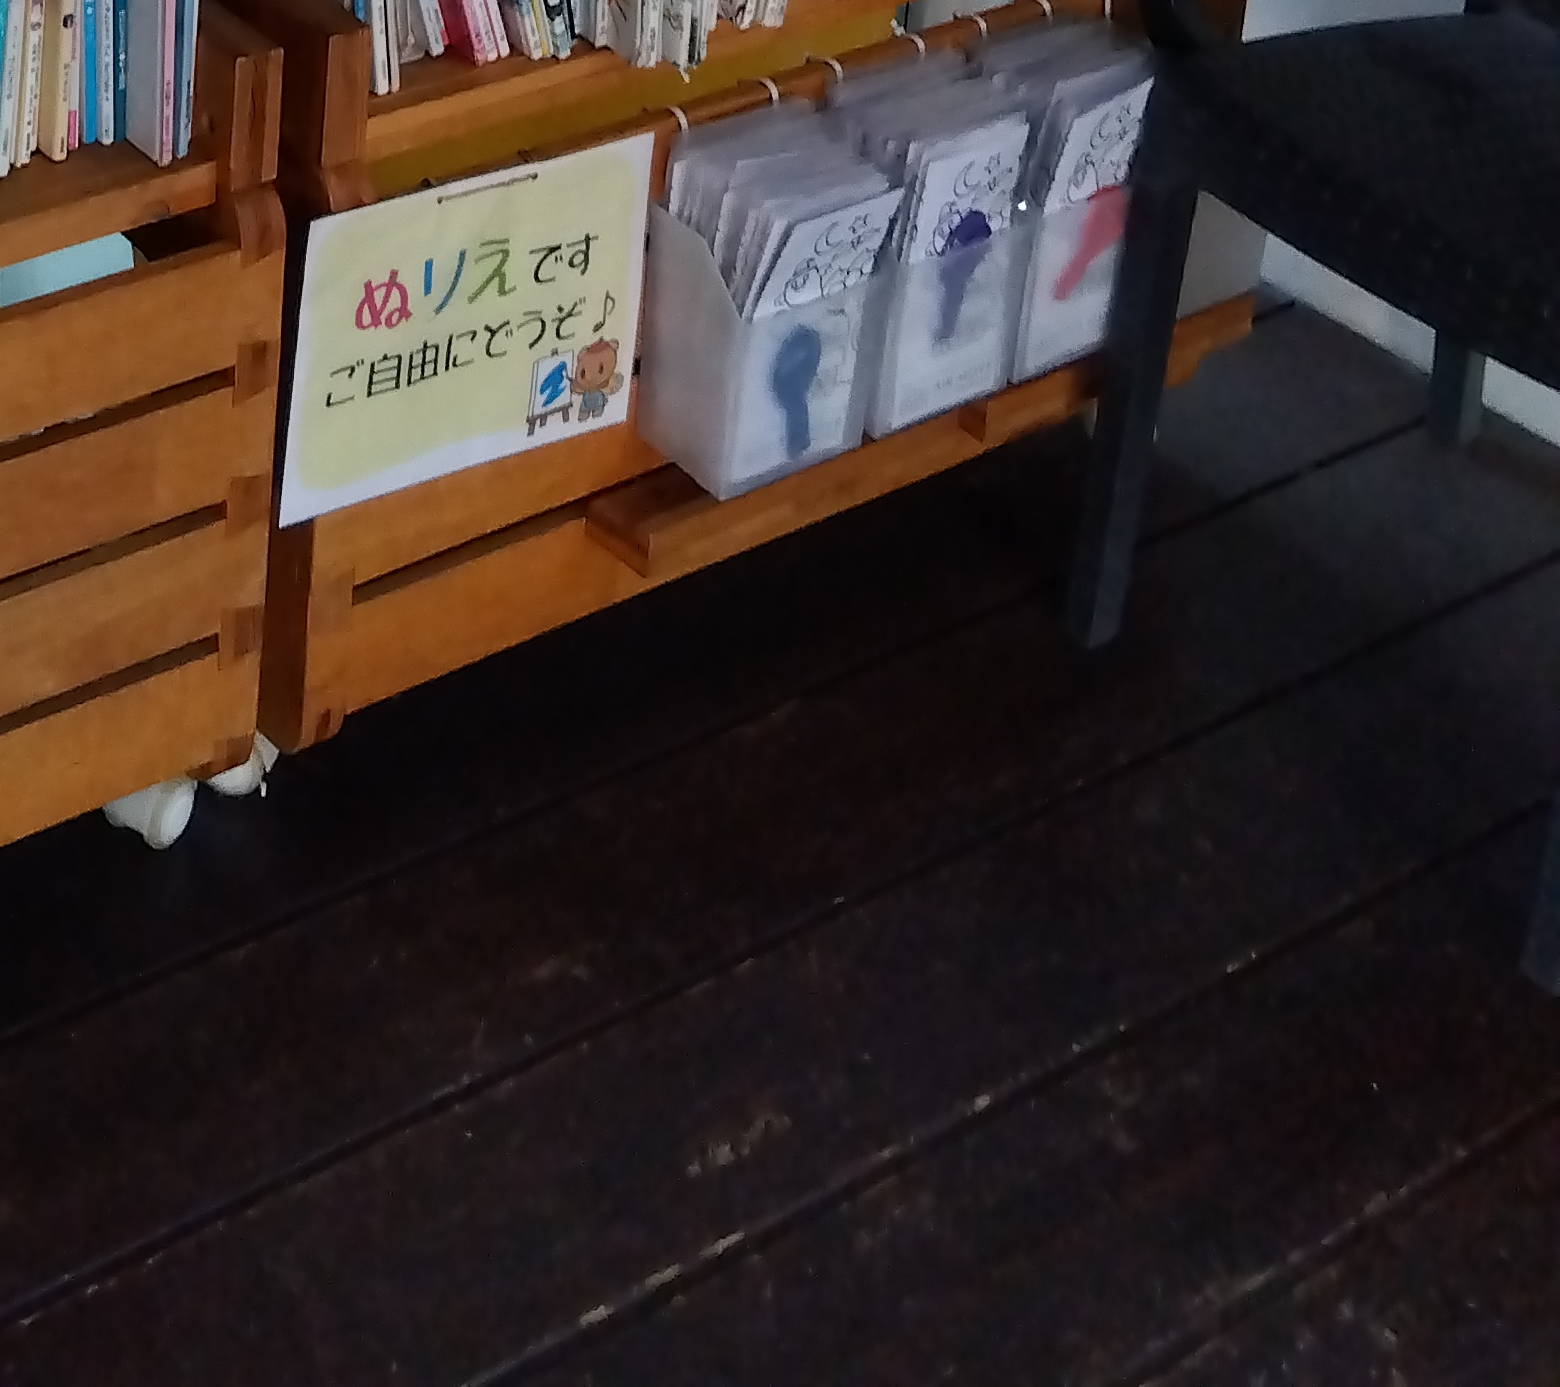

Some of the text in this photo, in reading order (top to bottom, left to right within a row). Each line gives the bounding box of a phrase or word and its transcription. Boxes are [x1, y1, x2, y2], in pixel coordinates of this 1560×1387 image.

[354, 232, 600, 331] ぬりえです
[324, 296, 588, 410] ご自由にどうぞ
